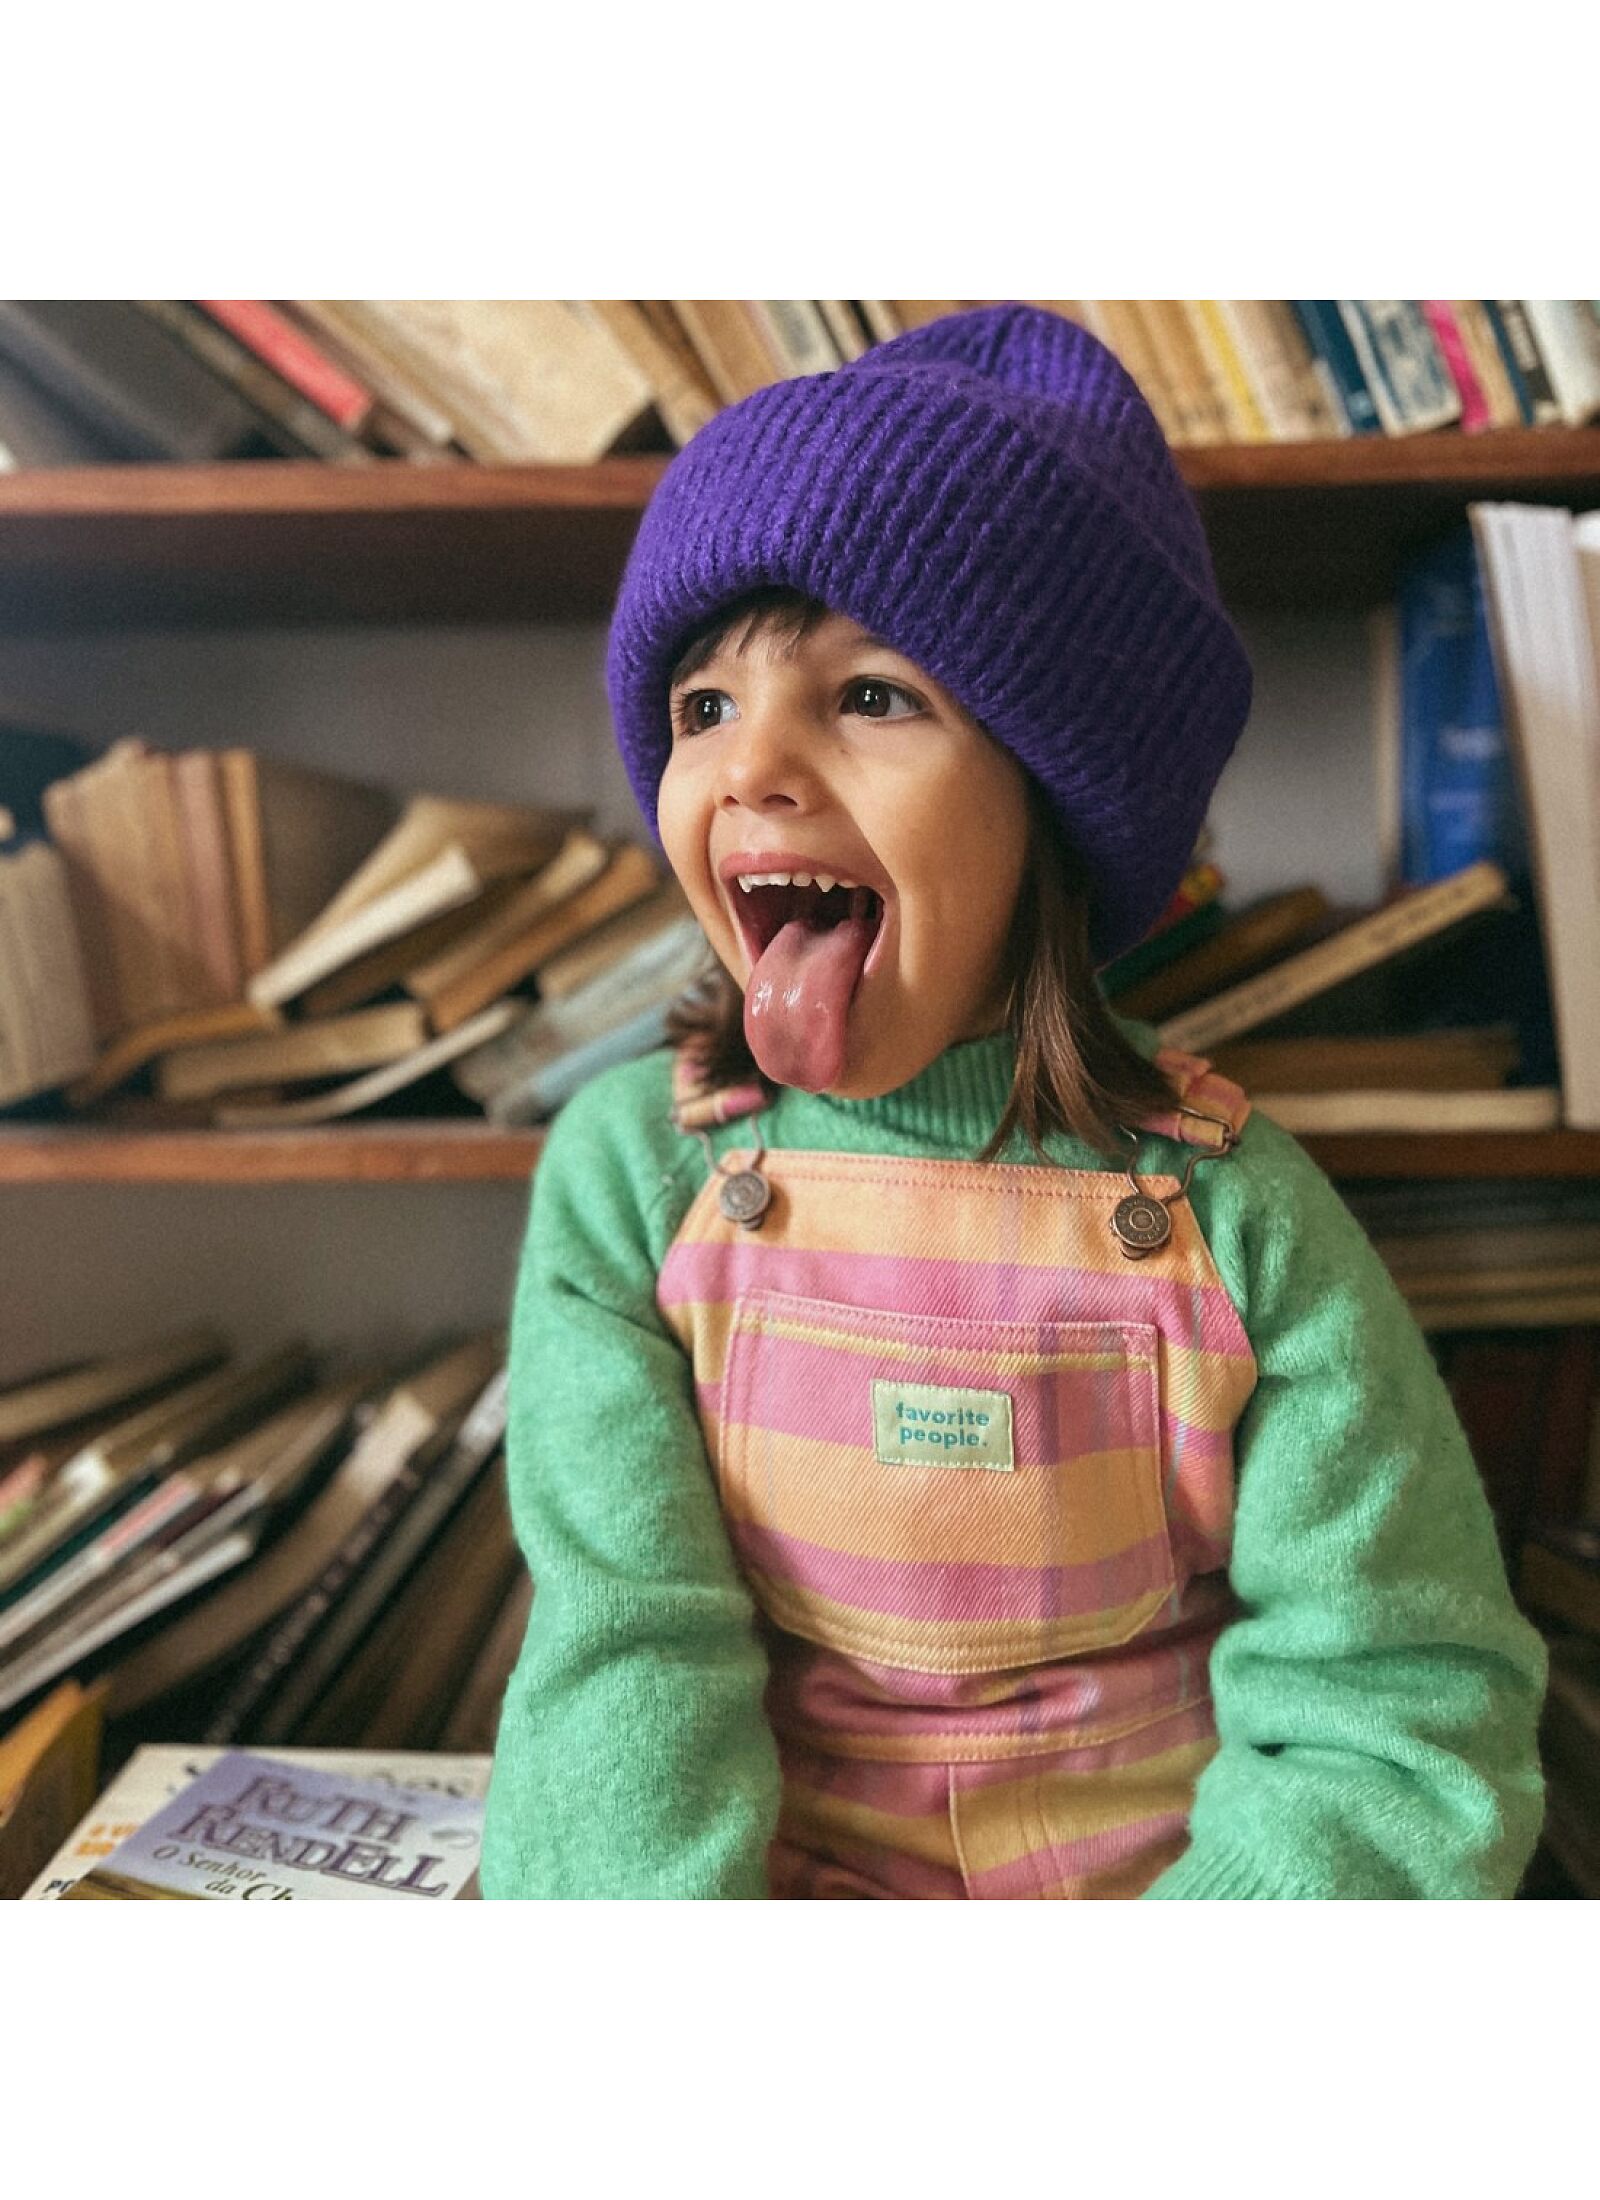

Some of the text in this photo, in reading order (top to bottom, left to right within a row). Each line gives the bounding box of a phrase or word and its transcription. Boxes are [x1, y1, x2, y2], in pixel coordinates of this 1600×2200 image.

[895, 1401, 990, 1428] favorite
[900, 1426, 988, 1449] people.
[234, 1775, 419, 1843] RUTH
[153, 1844, 267, 1881] O Senhor
[167, 1804, 449, 1897] RENDELL
[205, 1878, 236, 1895] da
